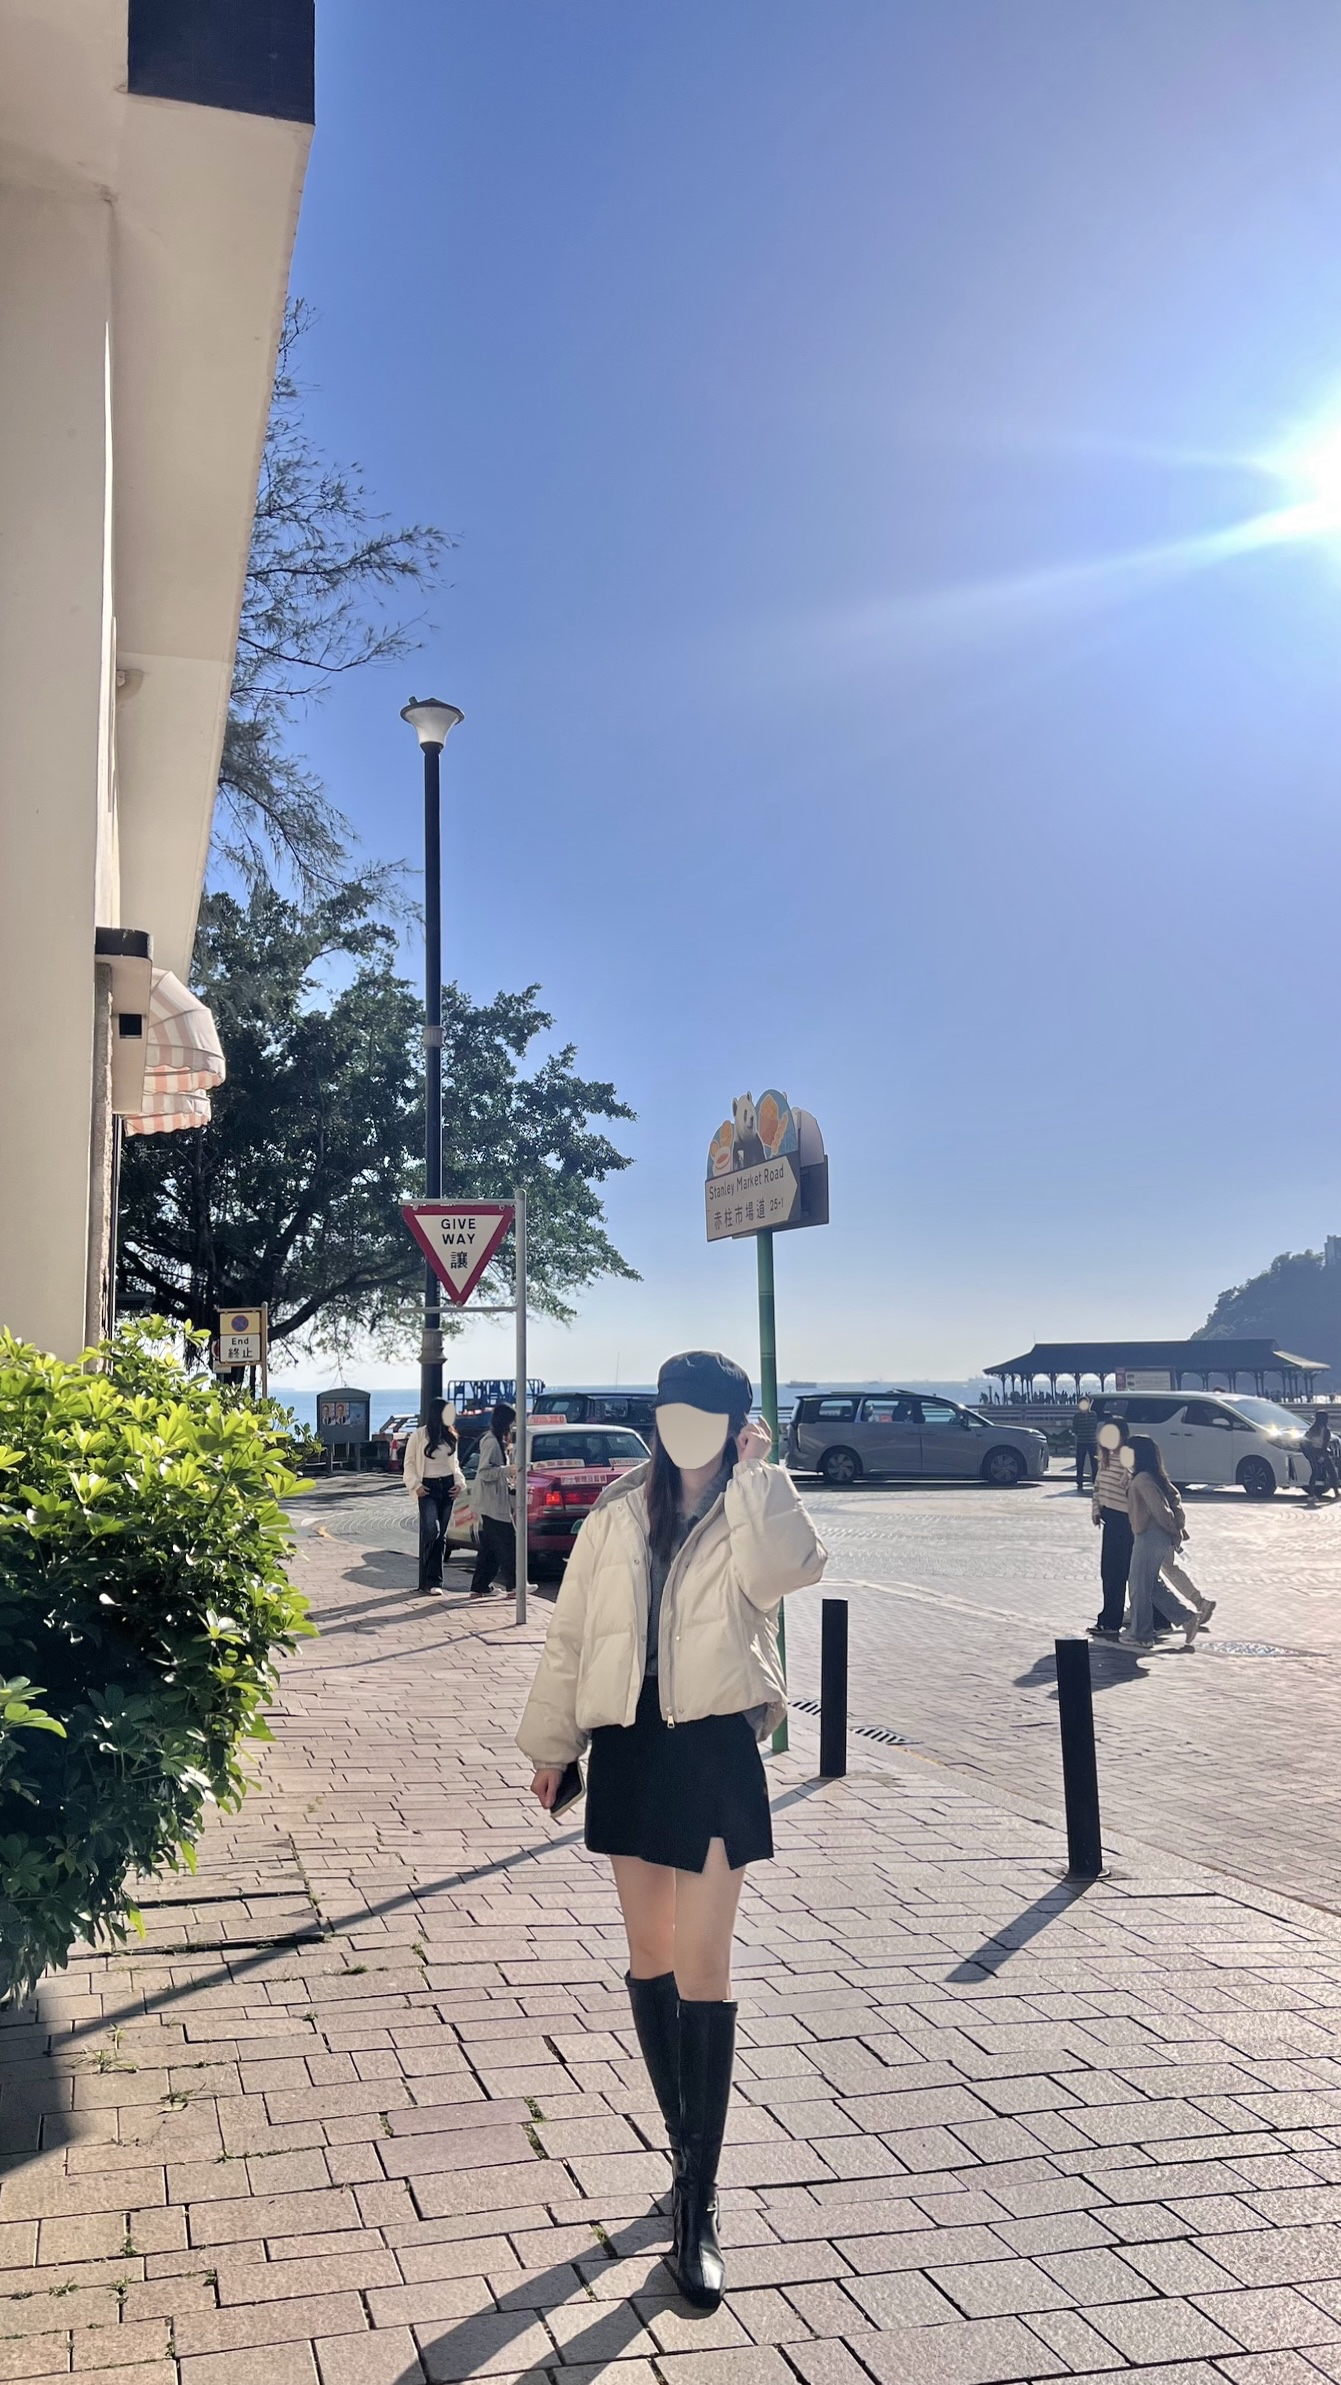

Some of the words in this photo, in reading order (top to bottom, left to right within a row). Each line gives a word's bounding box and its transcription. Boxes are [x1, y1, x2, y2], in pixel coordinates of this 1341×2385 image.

[709, 1181, 735, 1200] Stanley
[736, 1173, 762, 1193] Market
[764, 1163, 784, 1184] Road
[714, 1198, 766, 1230] 赤柱市場道
[441, 1218, 476, 1230] GIVE
[442, 1233, 476, 1245] WAY
[450, 1251, 468, 1269] 讓
[231, 1337, 249, 1346] End
[228, 1347, 253, 1359] 終止
